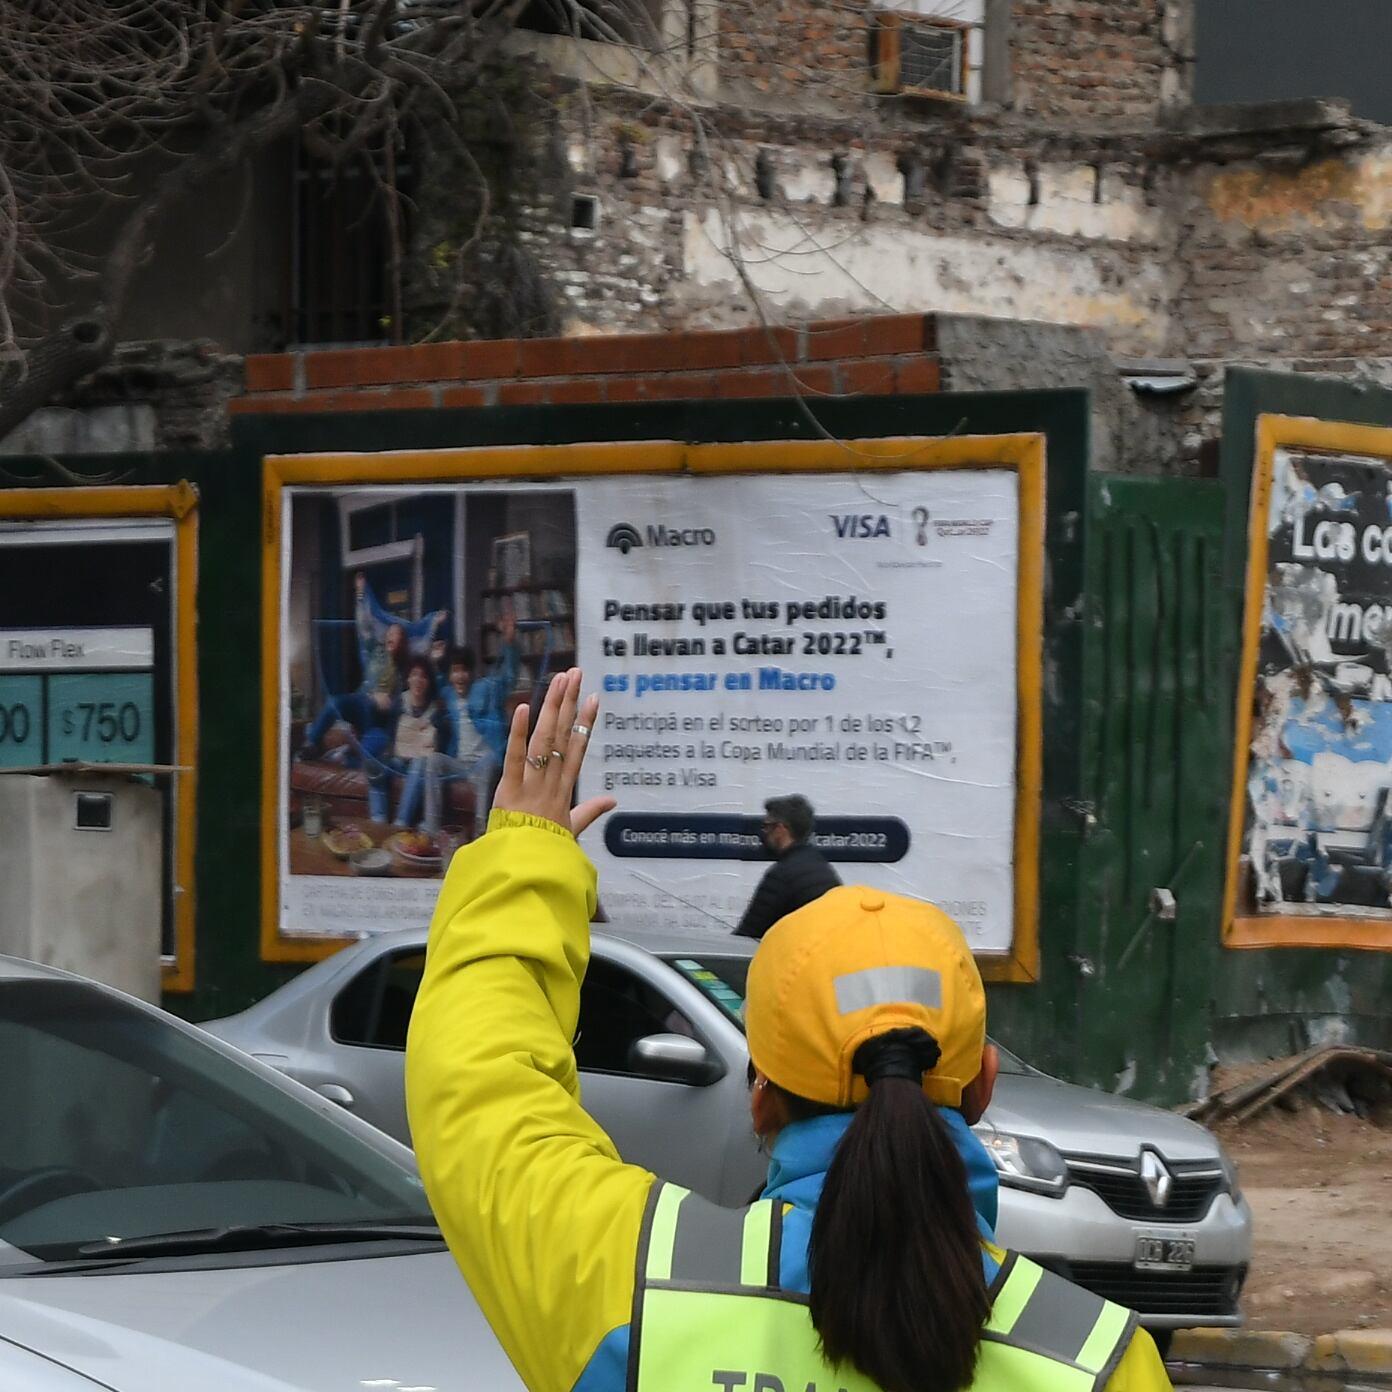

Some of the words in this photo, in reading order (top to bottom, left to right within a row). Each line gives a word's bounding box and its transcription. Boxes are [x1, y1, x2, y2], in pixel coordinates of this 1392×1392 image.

[647, 524, 716, 547] Macro
[828, 514, 891, 538] VISA
[603, 599, 686, 622] Pensar
[691, 602, 735, 626] que
[741, 598, 780, 620] tus
[786, 595, 887, 625] pedidos
[8, 639, 46, 659] Flow
[51, 638, 86, 658] Flex
[602, 635, 628, 657] te
[633, 632, 706, 656] llevan
[712, 636, 726, 655] a
[732, 631, 796, 655] Catar
[602, 672, 629, 692] es
[635, 671, 717, 697] pensar
[724, 671, 752, 691] en
[758, 666, 836, 692] Macro
[62, 701, 141, 743] $750
[604, 711, 678, 735] Participá
[682, 716, 704, 731] en
[709, 711, 724, 731] el
[729, 714, 784, 733] sorteo
[789, 717, 818, 737] por
[824, 714, 834, 733] 1
[840, 714, 862, 733] de
[868, 714, 893, 733] los
[604, 741, 681, 763] paquetes
[685, 744, 696, 759] a
[701, 740, 715, 759] la
[721, 740, 762, 763] Copa
[767, 741, 839, 761] Mundial
[846, 742, 868, 761] de
[874, 741, 889, 761] la
[604, 767, 662, 791] gracias
[667, 772, 676, 786] a
[680, 767, 717, 787] Visa
[622, 828, 668, 844] Conocé
[671, 829, 697, 845] más
[700, 834, 717, 845] en
